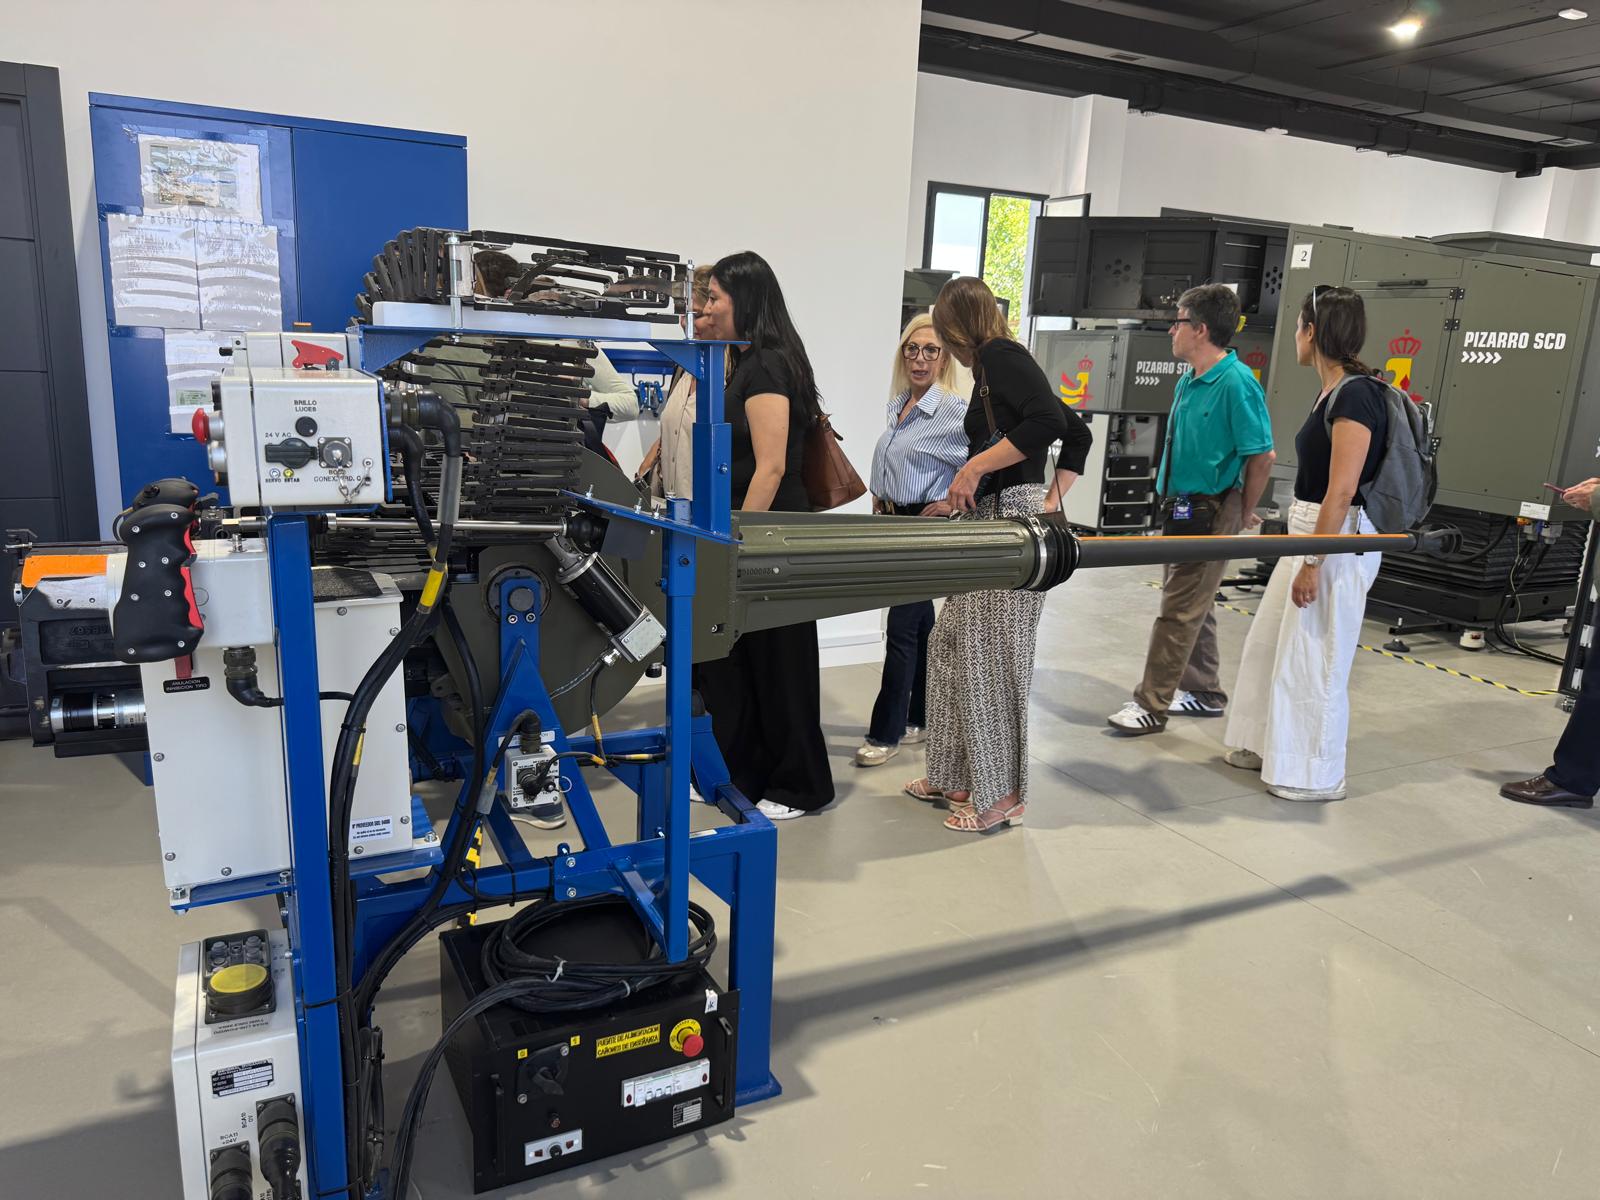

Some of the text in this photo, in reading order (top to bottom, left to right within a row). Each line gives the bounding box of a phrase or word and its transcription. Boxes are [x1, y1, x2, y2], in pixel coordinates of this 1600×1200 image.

[1300, 250, 1308, 262] 2
[1463, 331, 1567, 350] PIZARRO SCD
[1136, 361, 1175, 374] PIZARRO
